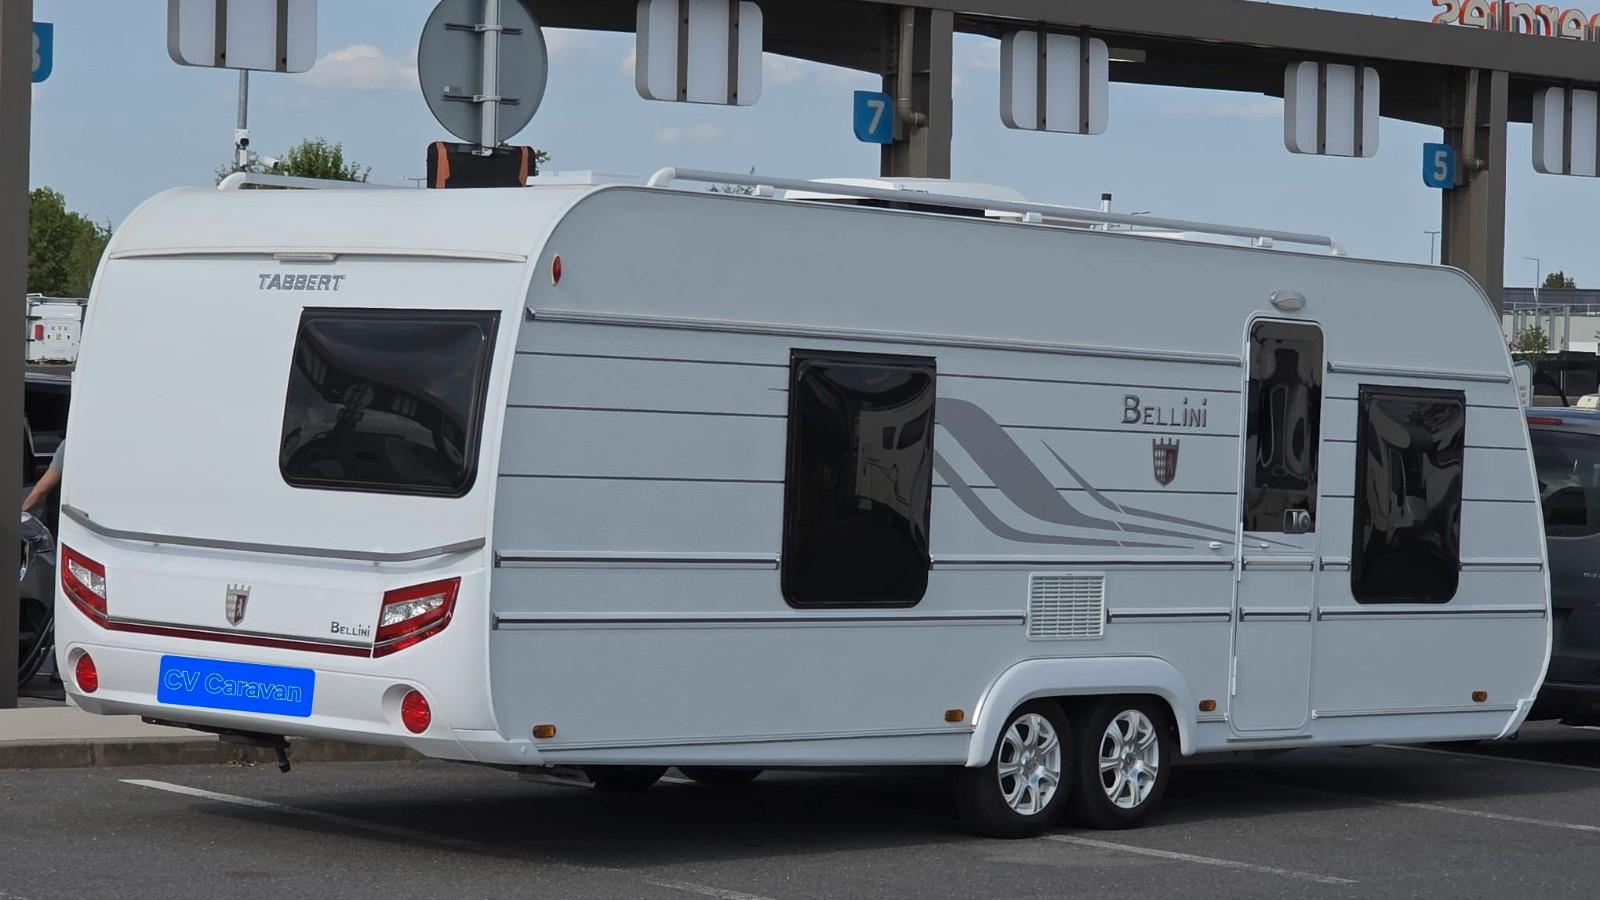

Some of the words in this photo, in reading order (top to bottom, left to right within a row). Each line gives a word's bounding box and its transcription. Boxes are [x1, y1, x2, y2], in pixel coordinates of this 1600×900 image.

[867, 100, 885, 134] 7
[1433, 150, 1448, 181] 5
[258, 273, 346, 291] TABBERT
